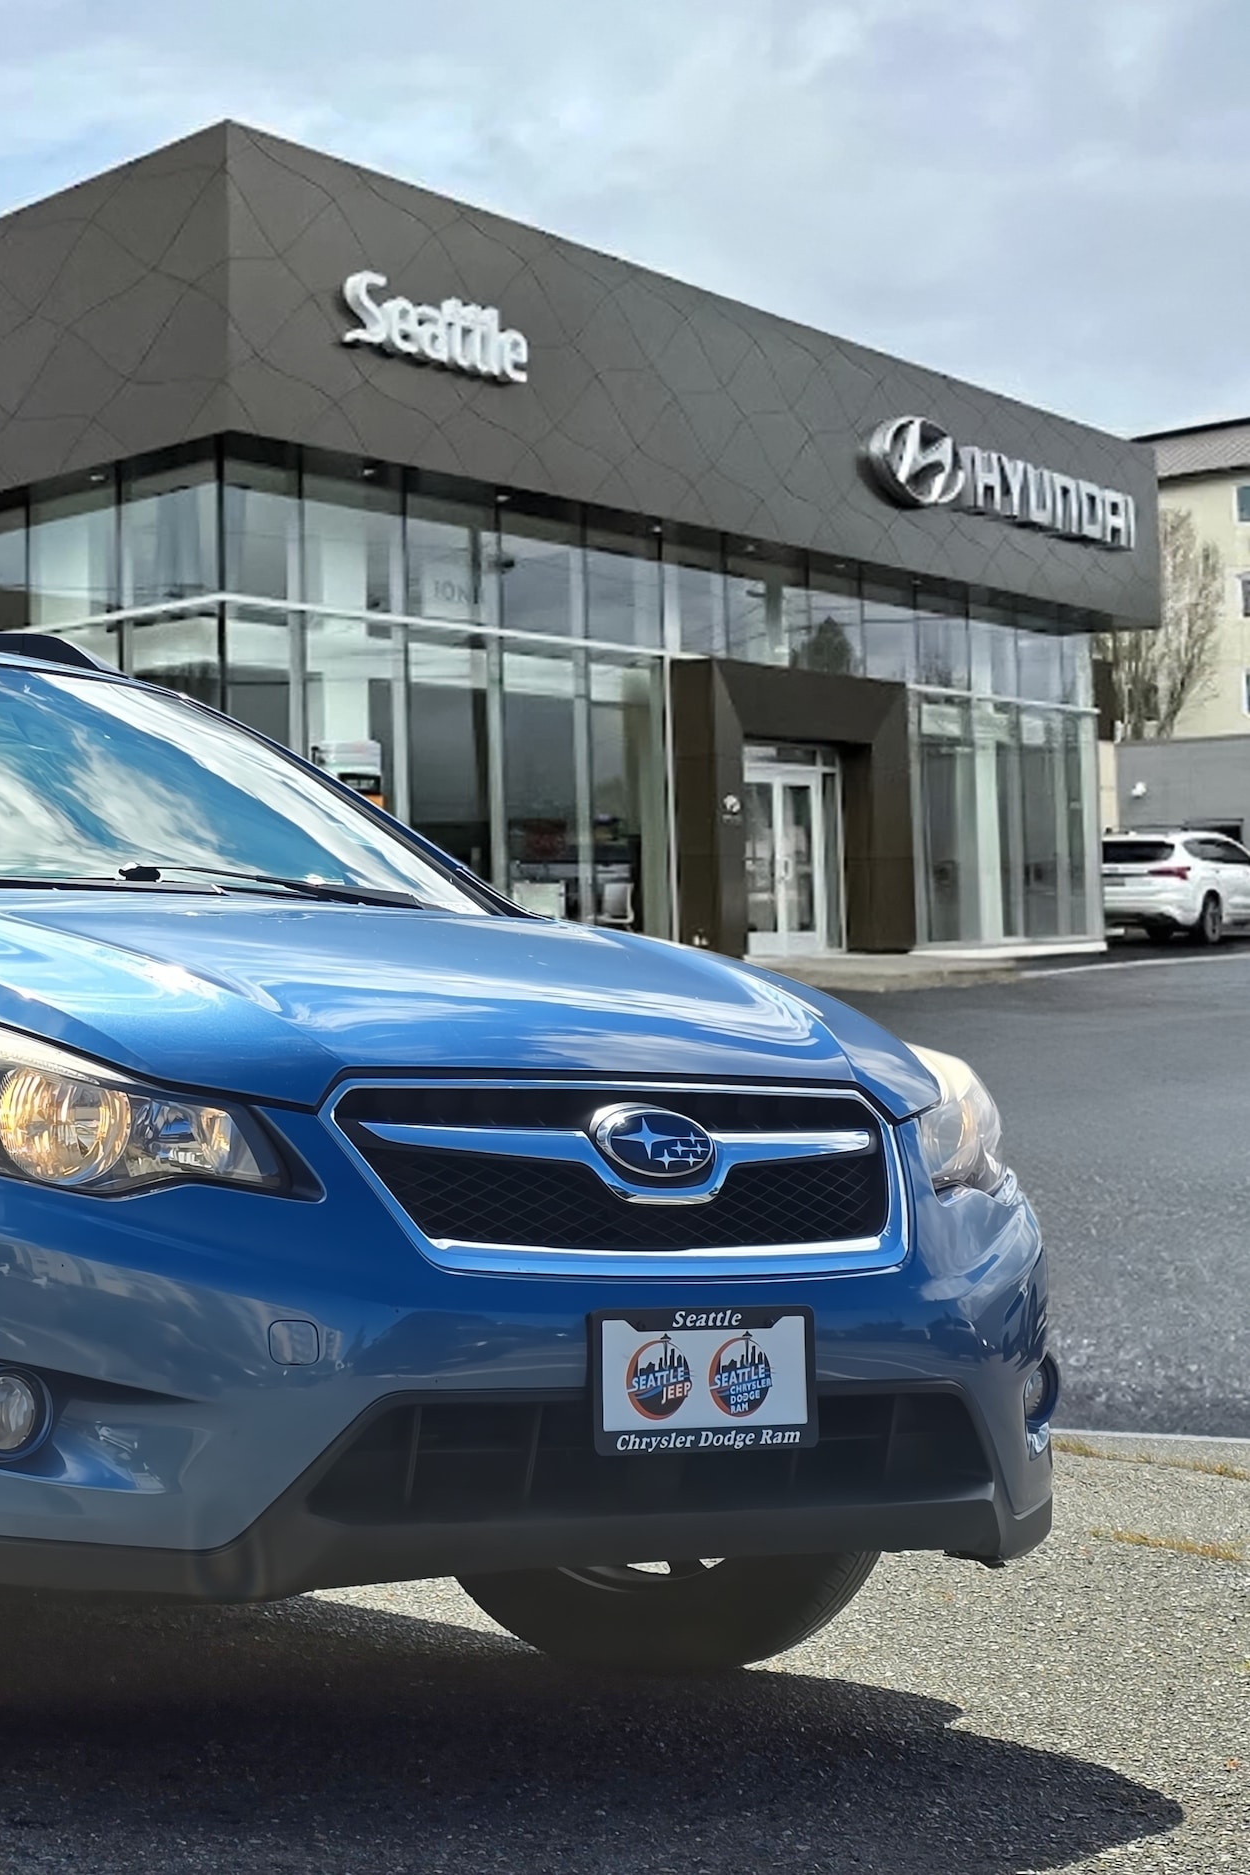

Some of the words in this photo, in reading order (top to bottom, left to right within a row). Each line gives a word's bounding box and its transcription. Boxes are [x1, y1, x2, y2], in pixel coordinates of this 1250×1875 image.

[343, 270, 528, 383] Seattle
[960, 446, 1136, 549] HYUNDAI
[672, 1309, 742, 1328] Seattle
[631, 1367, 685, 1391] SEATTLE
[714, 1364, 766, 1388] SEATTLE
[730, 1378, 772, 1395] CHRYSLER
[661, 1382, 692, 1404] JEEP
[730, 1391, 760, 1404] DODGE
[730, 1403, 749, 1414] RAM
[616, 1433, 694, 1452] Chrysler
[699, 1430, 755, 1449] Dodge
[760, 1430, 800, 1445] Ram
